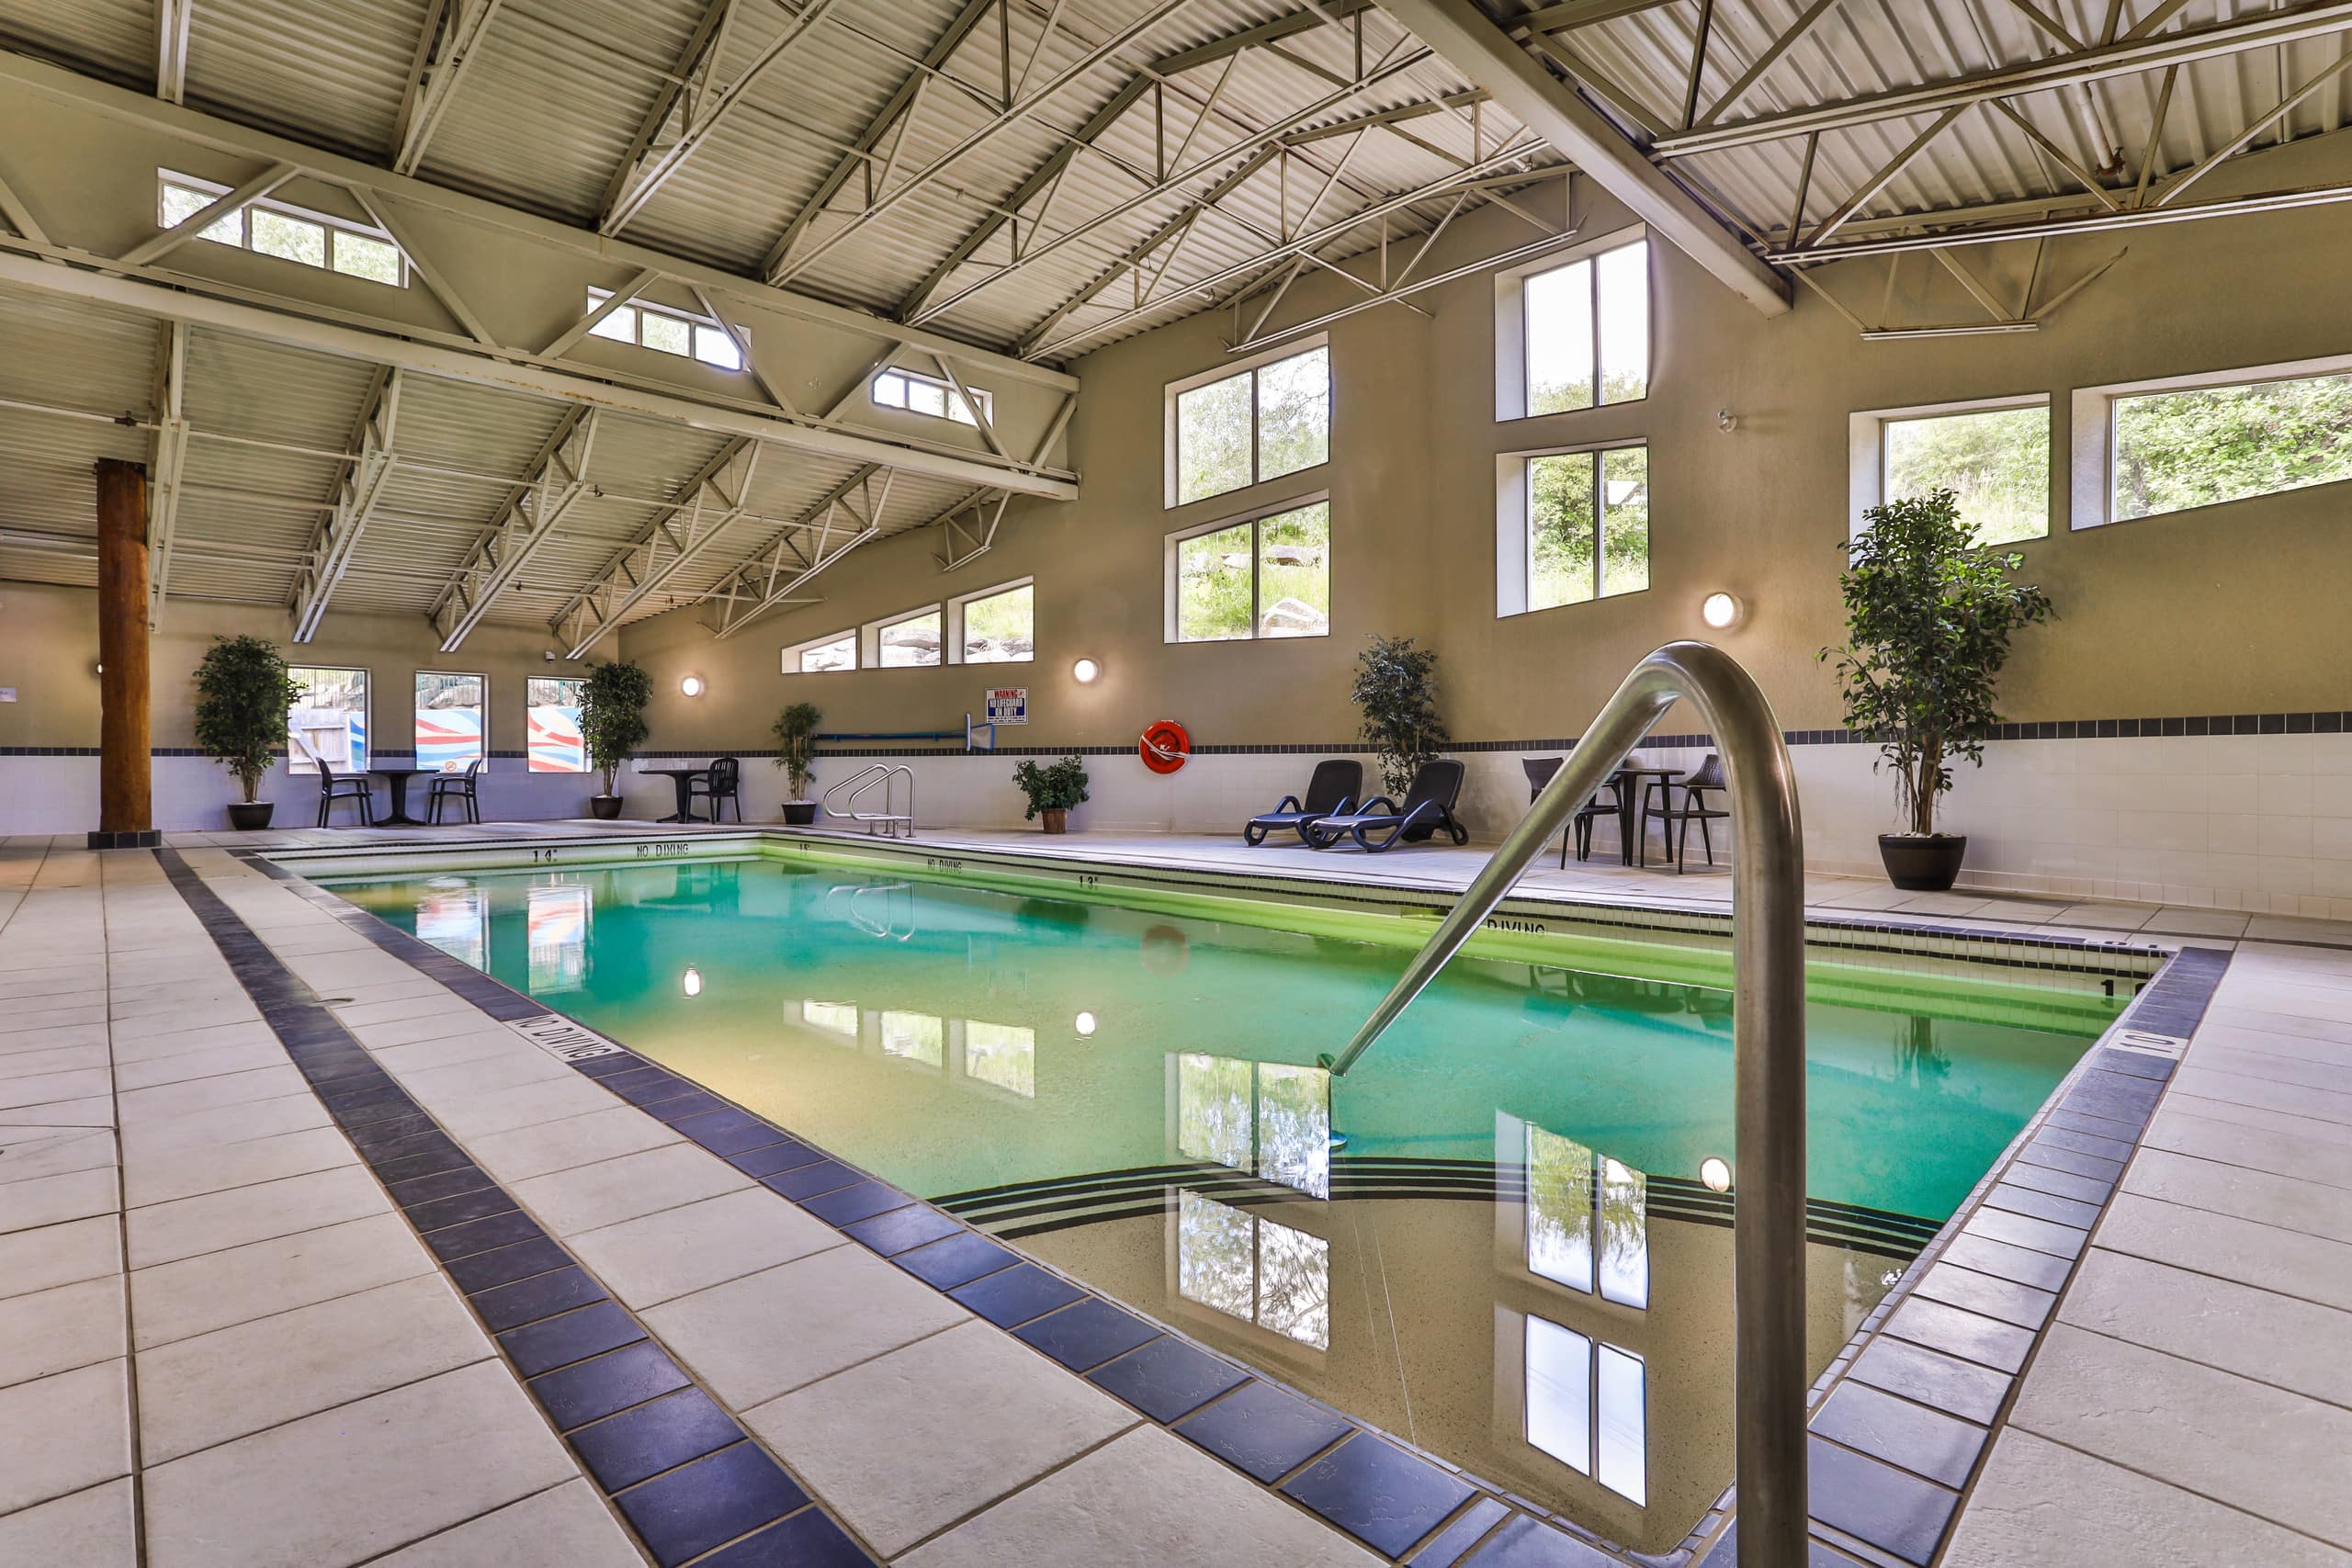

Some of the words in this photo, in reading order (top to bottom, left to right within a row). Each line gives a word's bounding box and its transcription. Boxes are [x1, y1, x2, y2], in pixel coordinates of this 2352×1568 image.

[994, 690, 1017, 698] WARNING
[989, 699, 996, 707] NO
[998, 698, 1023, 706] LIFEGUARD
[995, 707, 1002, 716] ON
[1004, 707, 1017, 716] DUTY
[513, 1014, 560, 1028] NO
[532, 1027, 612, 1057] DIVING
